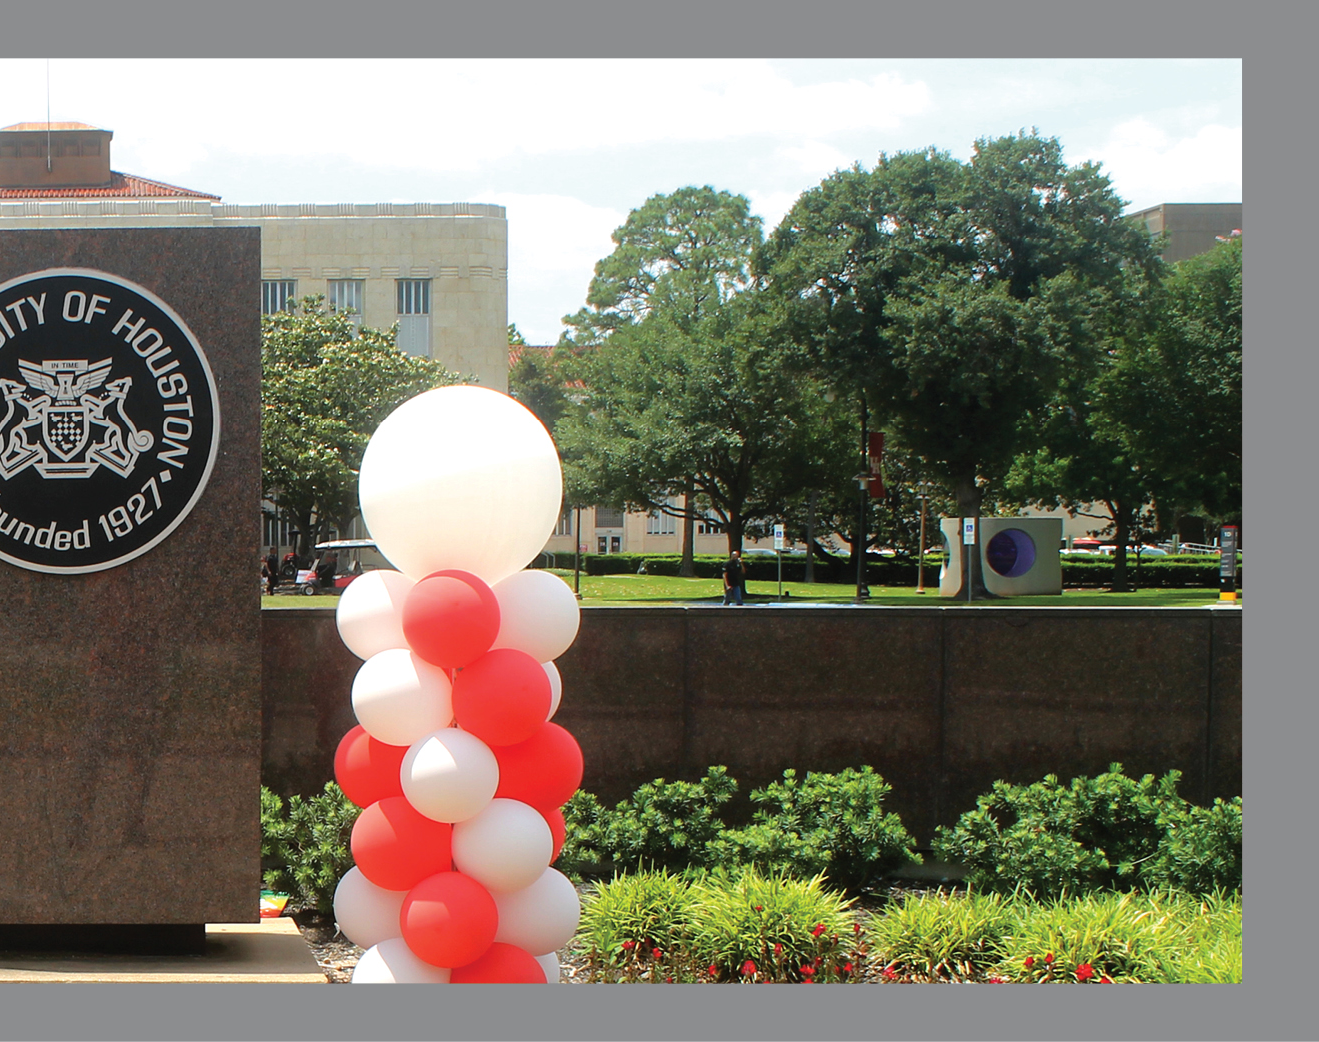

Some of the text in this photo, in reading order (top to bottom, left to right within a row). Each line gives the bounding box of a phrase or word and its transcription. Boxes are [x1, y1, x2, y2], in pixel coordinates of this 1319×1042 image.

[62, 290, 111, 324] OF
[111, 308, 194, 469] HOUSTON
[98, 476, 162, 542] 1927
